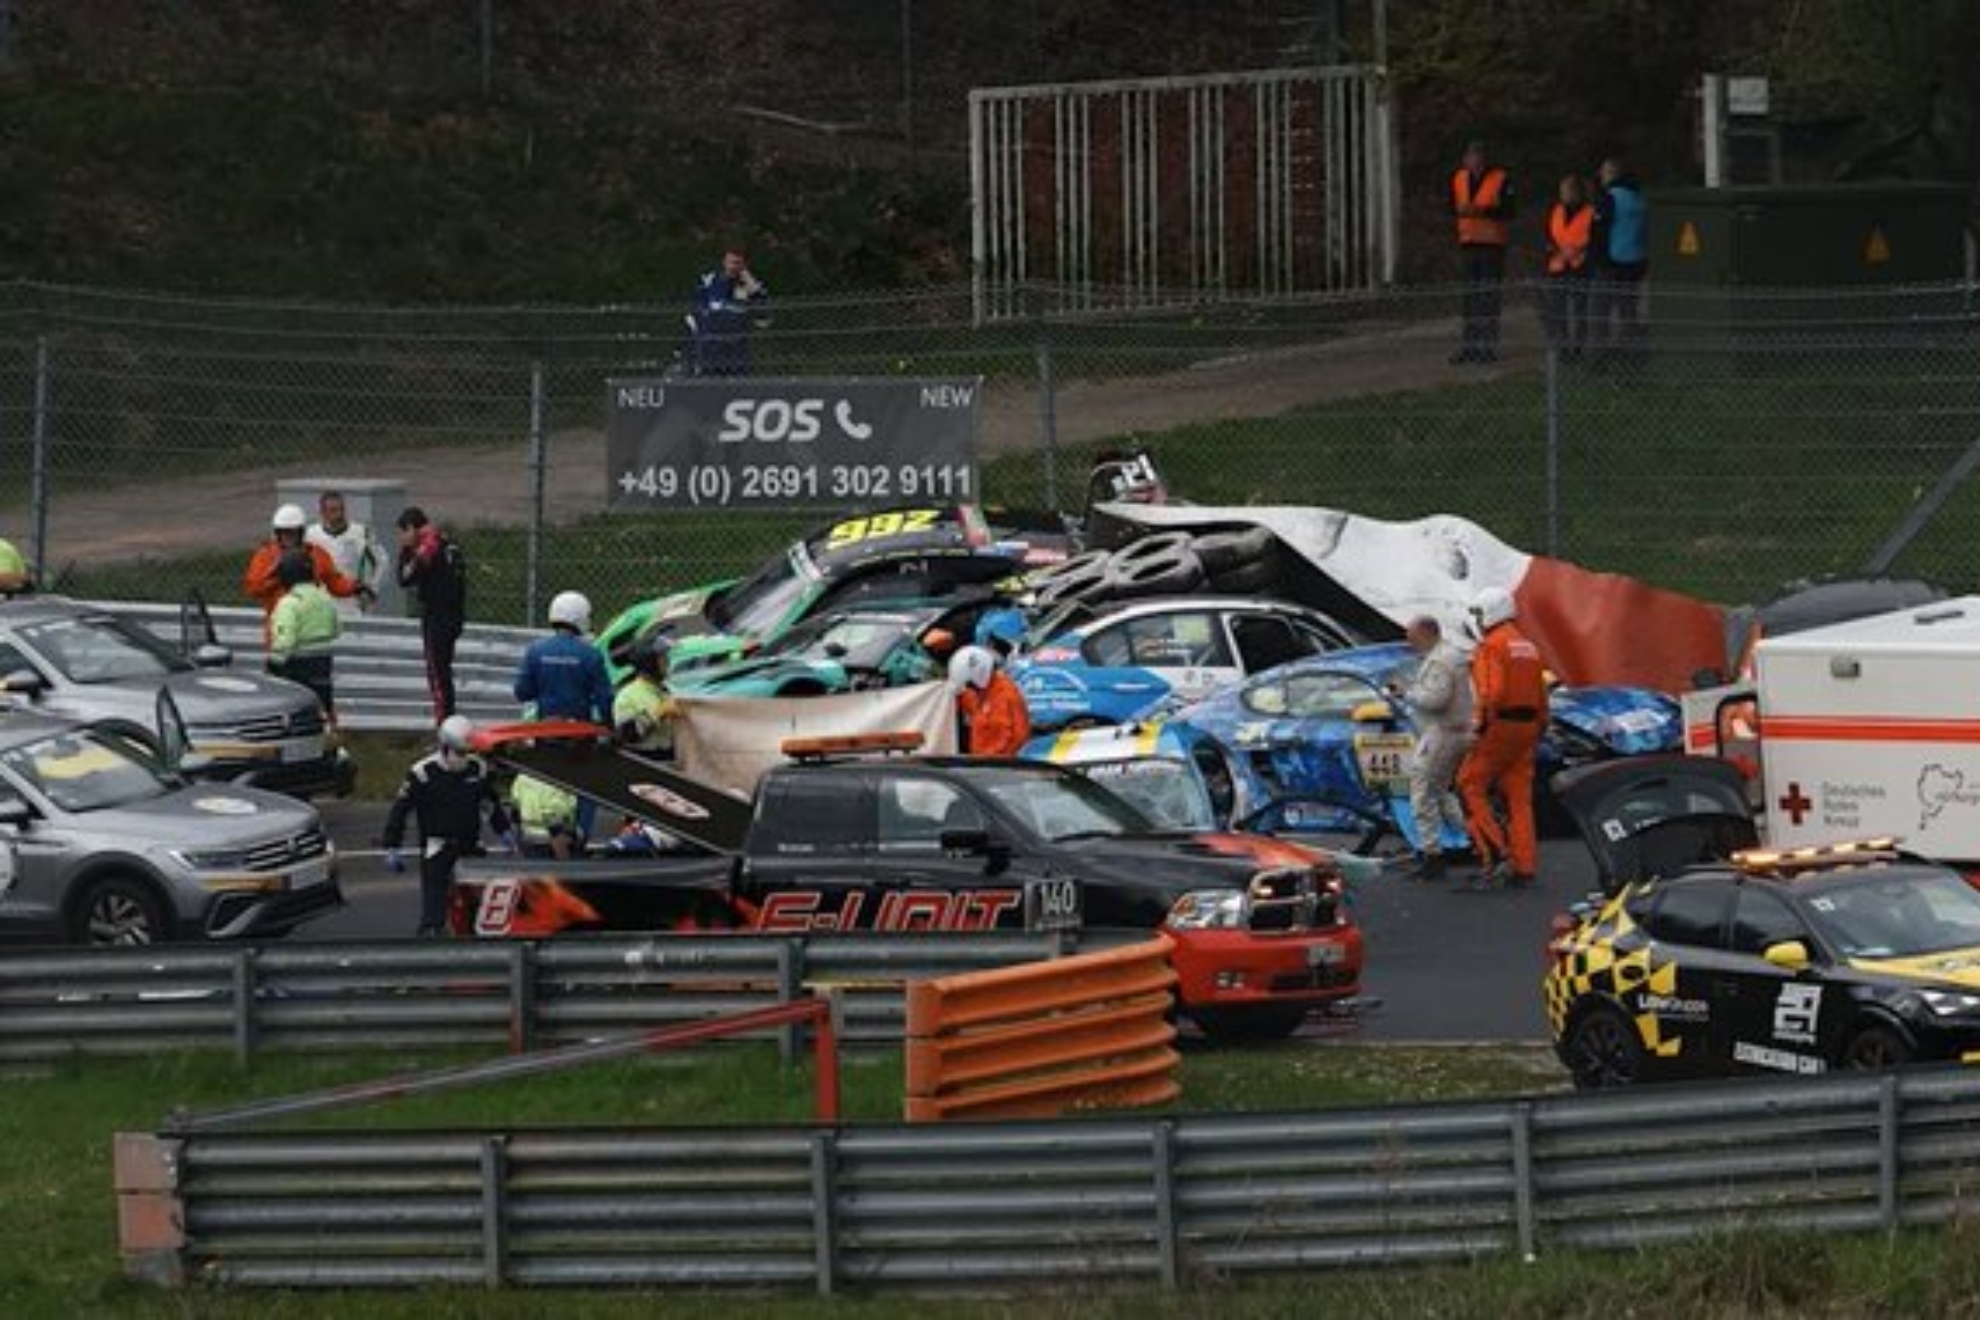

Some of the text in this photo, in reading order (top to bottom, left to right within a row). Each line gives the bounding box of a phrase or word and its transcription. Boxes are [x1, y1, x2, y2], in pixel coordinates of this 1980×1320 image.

[617, 388, 665, 407] NEU
[920, 387, 974, 407] NEW
[718, 399, 824, 442] SOS
[618, 465, 971, 504] +49 (0) 2691 302 9111
